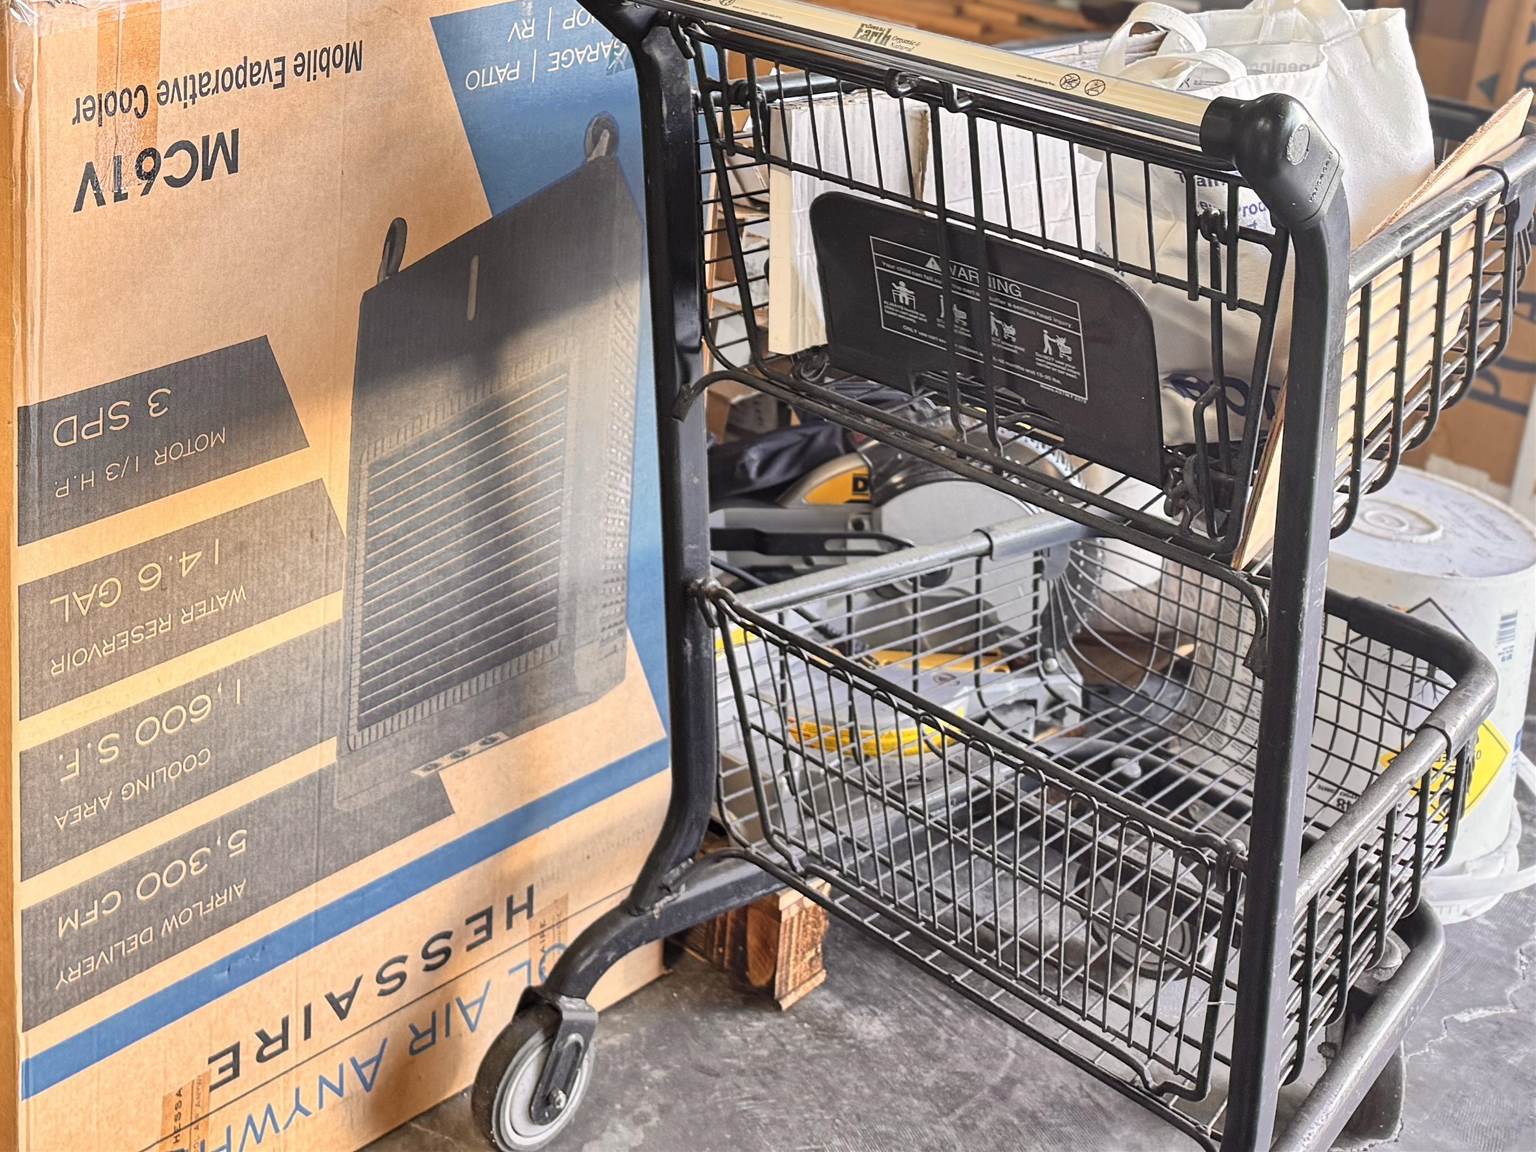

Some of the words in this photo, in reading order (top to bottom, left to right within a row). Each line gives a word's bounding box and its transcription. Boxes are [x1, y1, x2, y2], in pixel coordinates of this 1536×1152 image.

[508, 17, 535, 42] RV
[156, 55, 287, 109] Evaporative
[292, 40, 364, 82] Mobile
[465, 60, 520, 91] PATIO
[71, 84, 149, 128] Cooler
[72, 128, 240, 214] MC61V
[949, 264, 1023, 298] WARING
[52, 400, 130, 447] SPD
[147, 387, 172, 417] 3
[153, 426, 227, 466] MOTOR
[137, 538, 220, 593] 14.6
[50, 576, 122, 623] GAL
[180, 584, 247, 625] WATER
[50, 613, 173, 677] RESERVOIR
[135, 678, 242, 746] 1,600
[121, 747, 212, 801] COOLING
[54, 790, 113, 831] AREA
[135, 829, 248, 901] 5,300
[56, 889, 122, 939] CFM
[161, 878, 248, 938] AIRFLOW
[54, 926, 153, 991] DELIVERY
[208, 884, 535, 1093] HESSAIRE
[408, 979, 492, 1059] AIR
